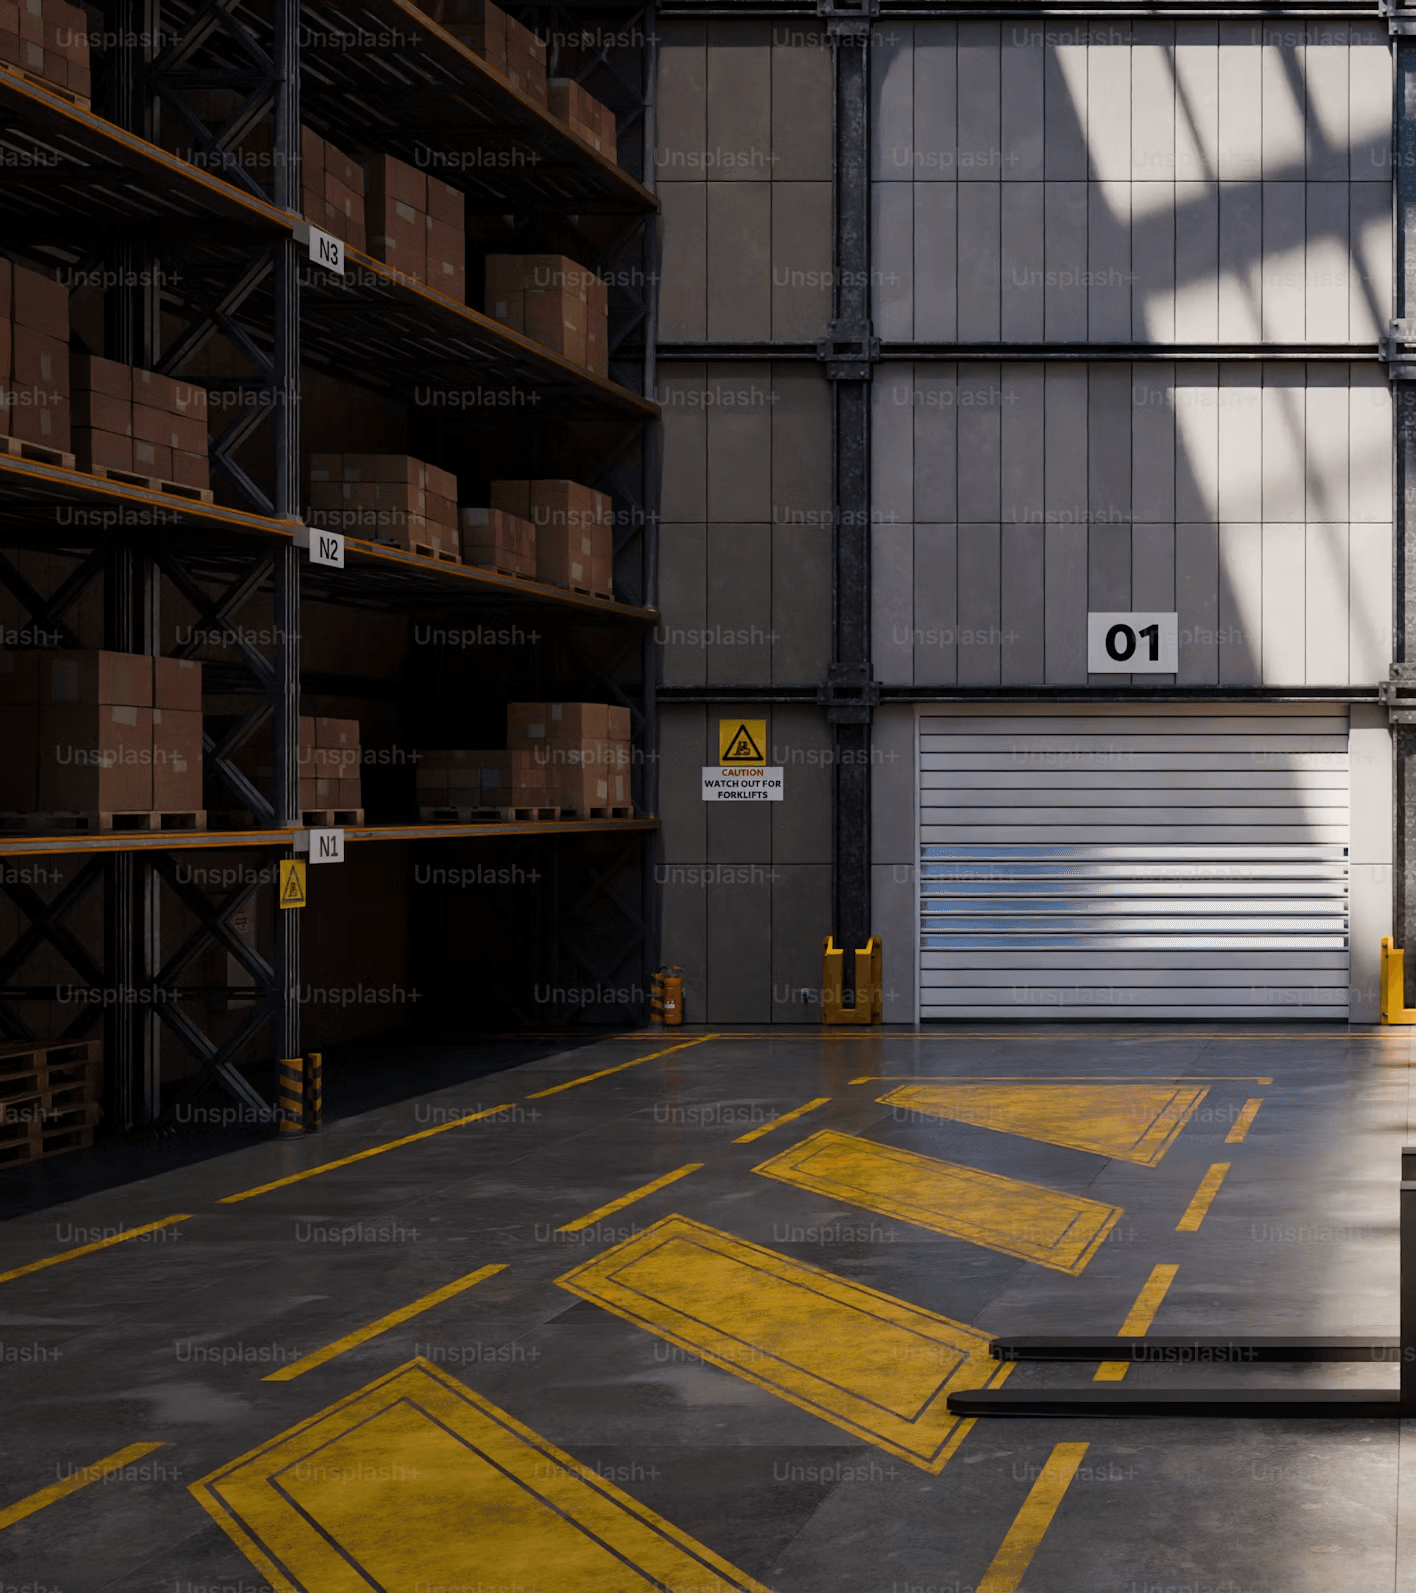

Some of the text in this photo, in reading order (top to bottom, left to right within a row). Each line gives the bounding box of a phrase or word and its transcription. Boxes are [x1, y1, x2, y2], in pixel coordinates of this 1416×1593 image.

[320, 237, 338, 265] N3
[320, 536, 338, 561] N2
[1105, 623, 1159, 662] 01
[721, 768, 765, 777] CAUTION
[704, 780, 782, 788] WATCH OUT FOR
[718, 791, 768, 799] FORKLIFTS
[320, 836, 338, 857] N1
